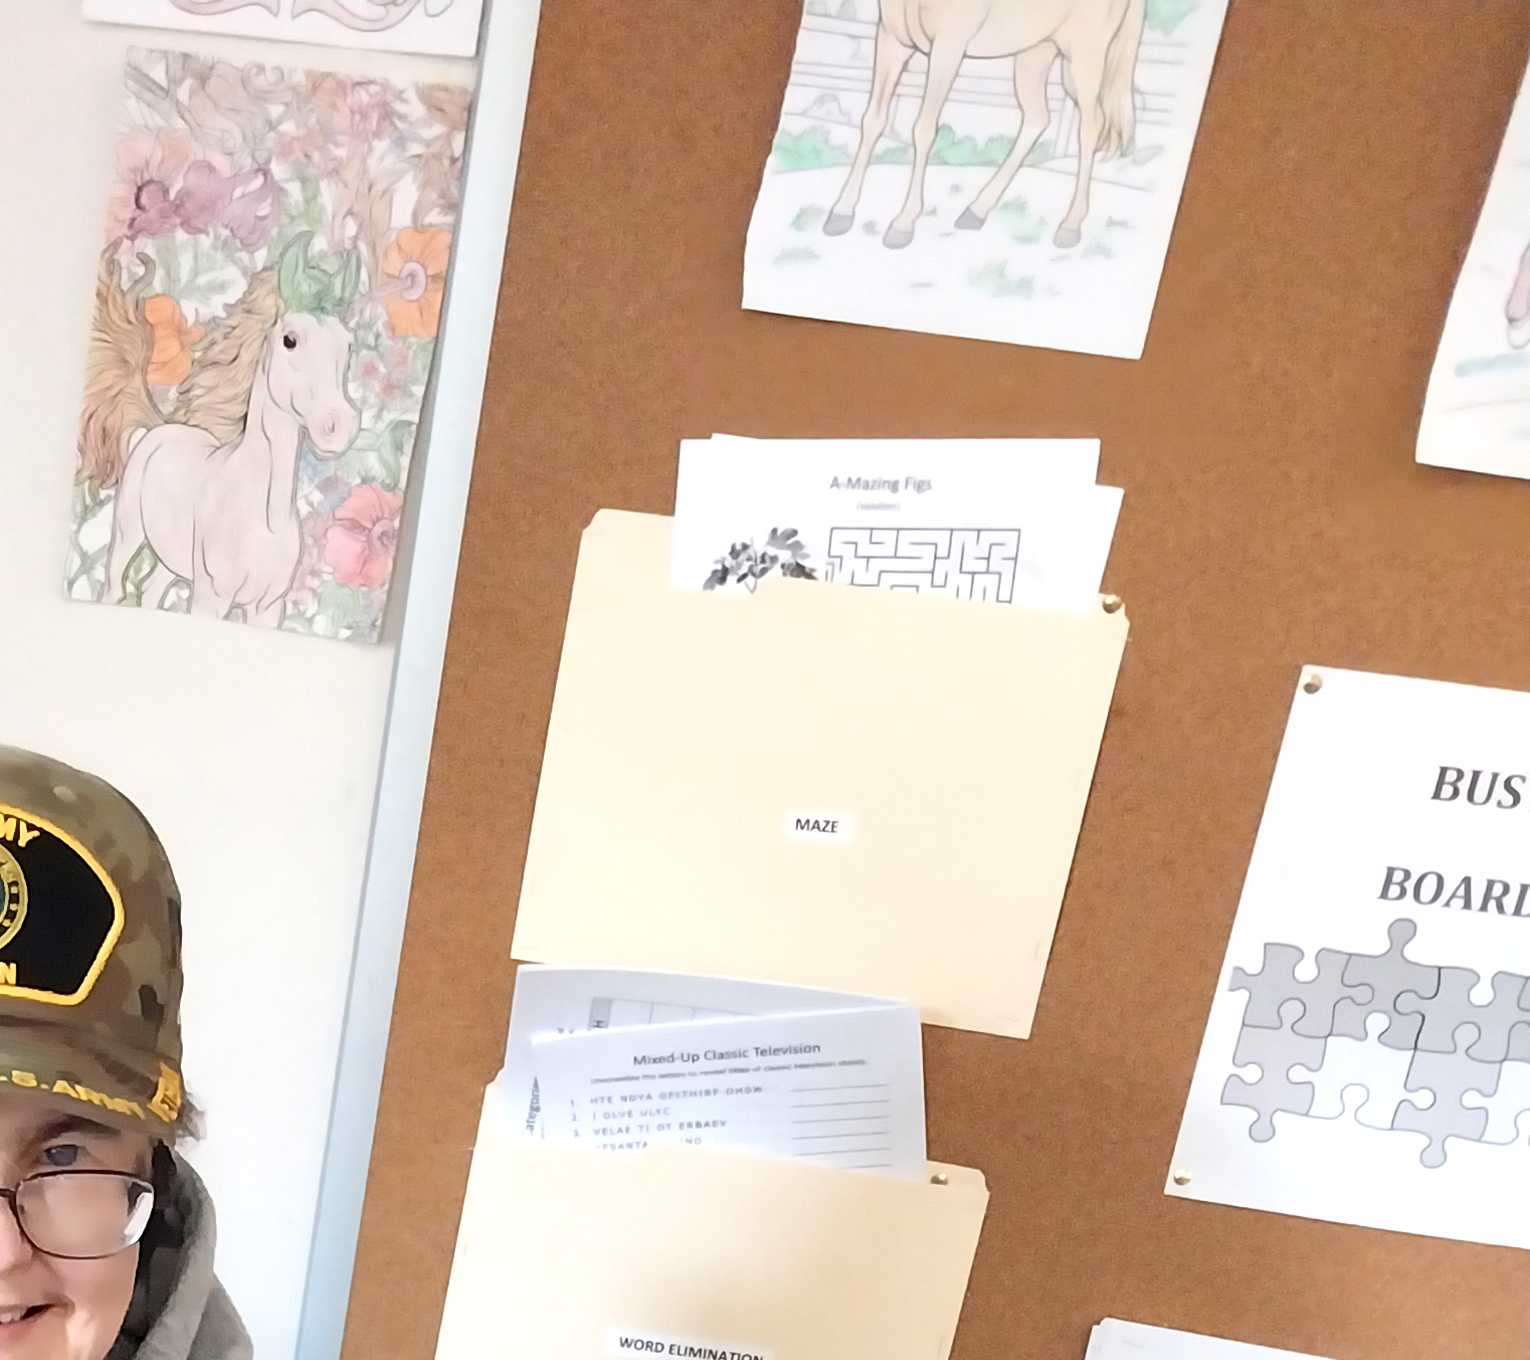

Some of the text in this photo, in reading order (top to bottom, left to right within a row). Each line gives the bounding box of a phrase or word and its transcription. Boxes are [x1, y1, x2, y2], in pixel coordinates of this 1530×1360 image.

[905, 476, 932, 494] Figs
[1430, 765, 1529, 809] BUS
[795, 818, 839, 833] MAZE
[633, 1043, 822, 1067] Mixed-Up Classic Television
[619, 1336, 665, 1354] WORD
